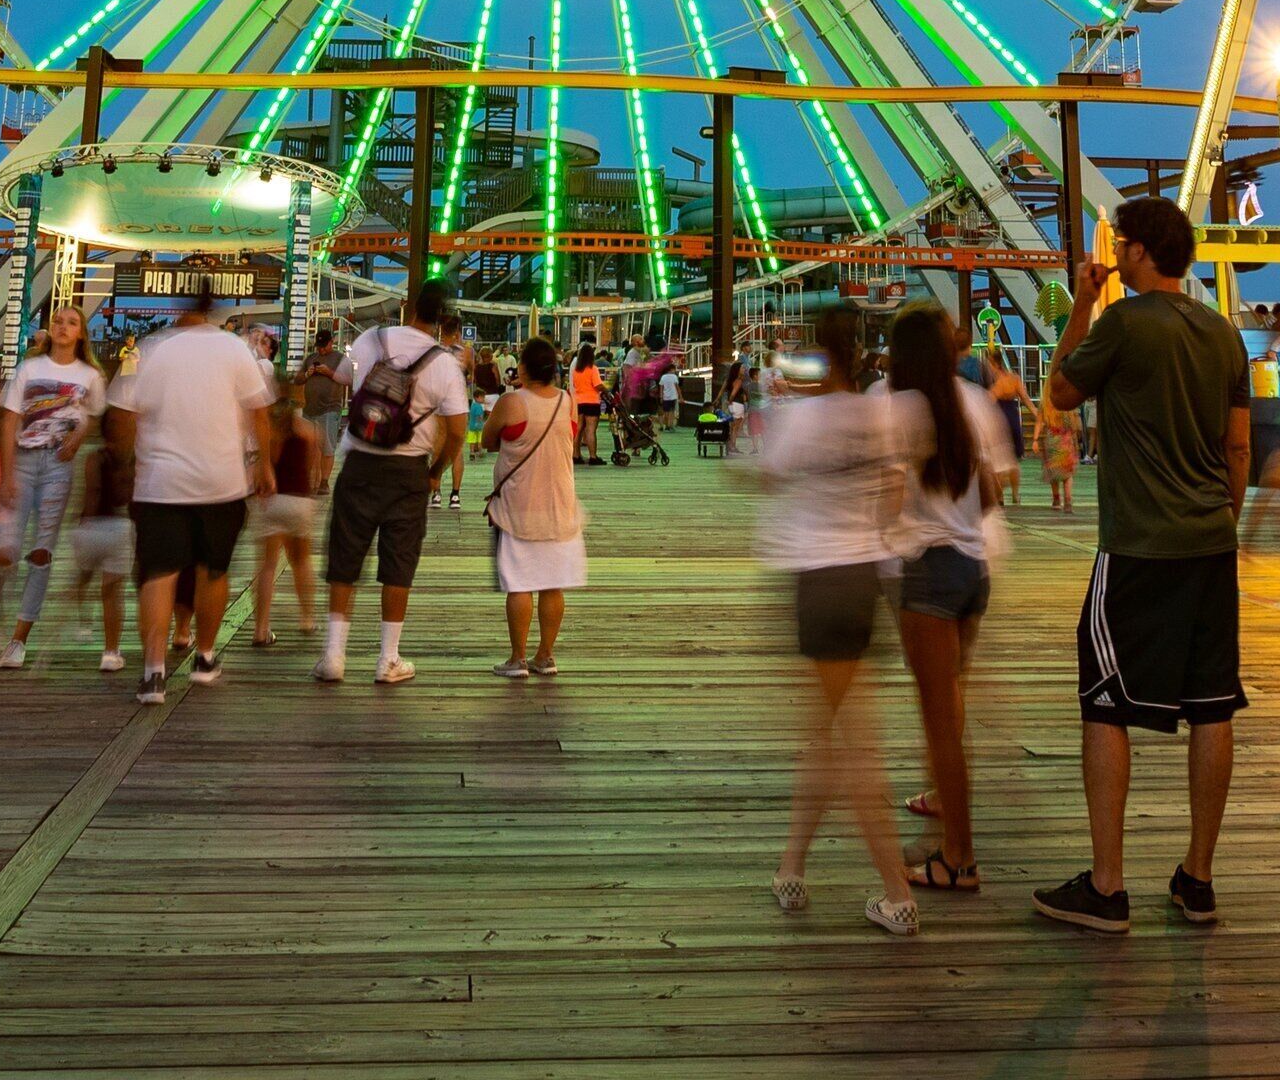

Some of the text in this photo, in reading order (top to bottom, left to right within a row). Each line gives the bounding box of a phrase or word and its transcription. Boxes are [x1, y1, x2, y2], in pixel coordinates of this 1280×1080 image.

[0, 207, 32, 381] PIER PERFORMERS
[143, 271, 254, 296] PIER PERFORMERS
[286, 213, 311, 376] PIER PERFORMER
